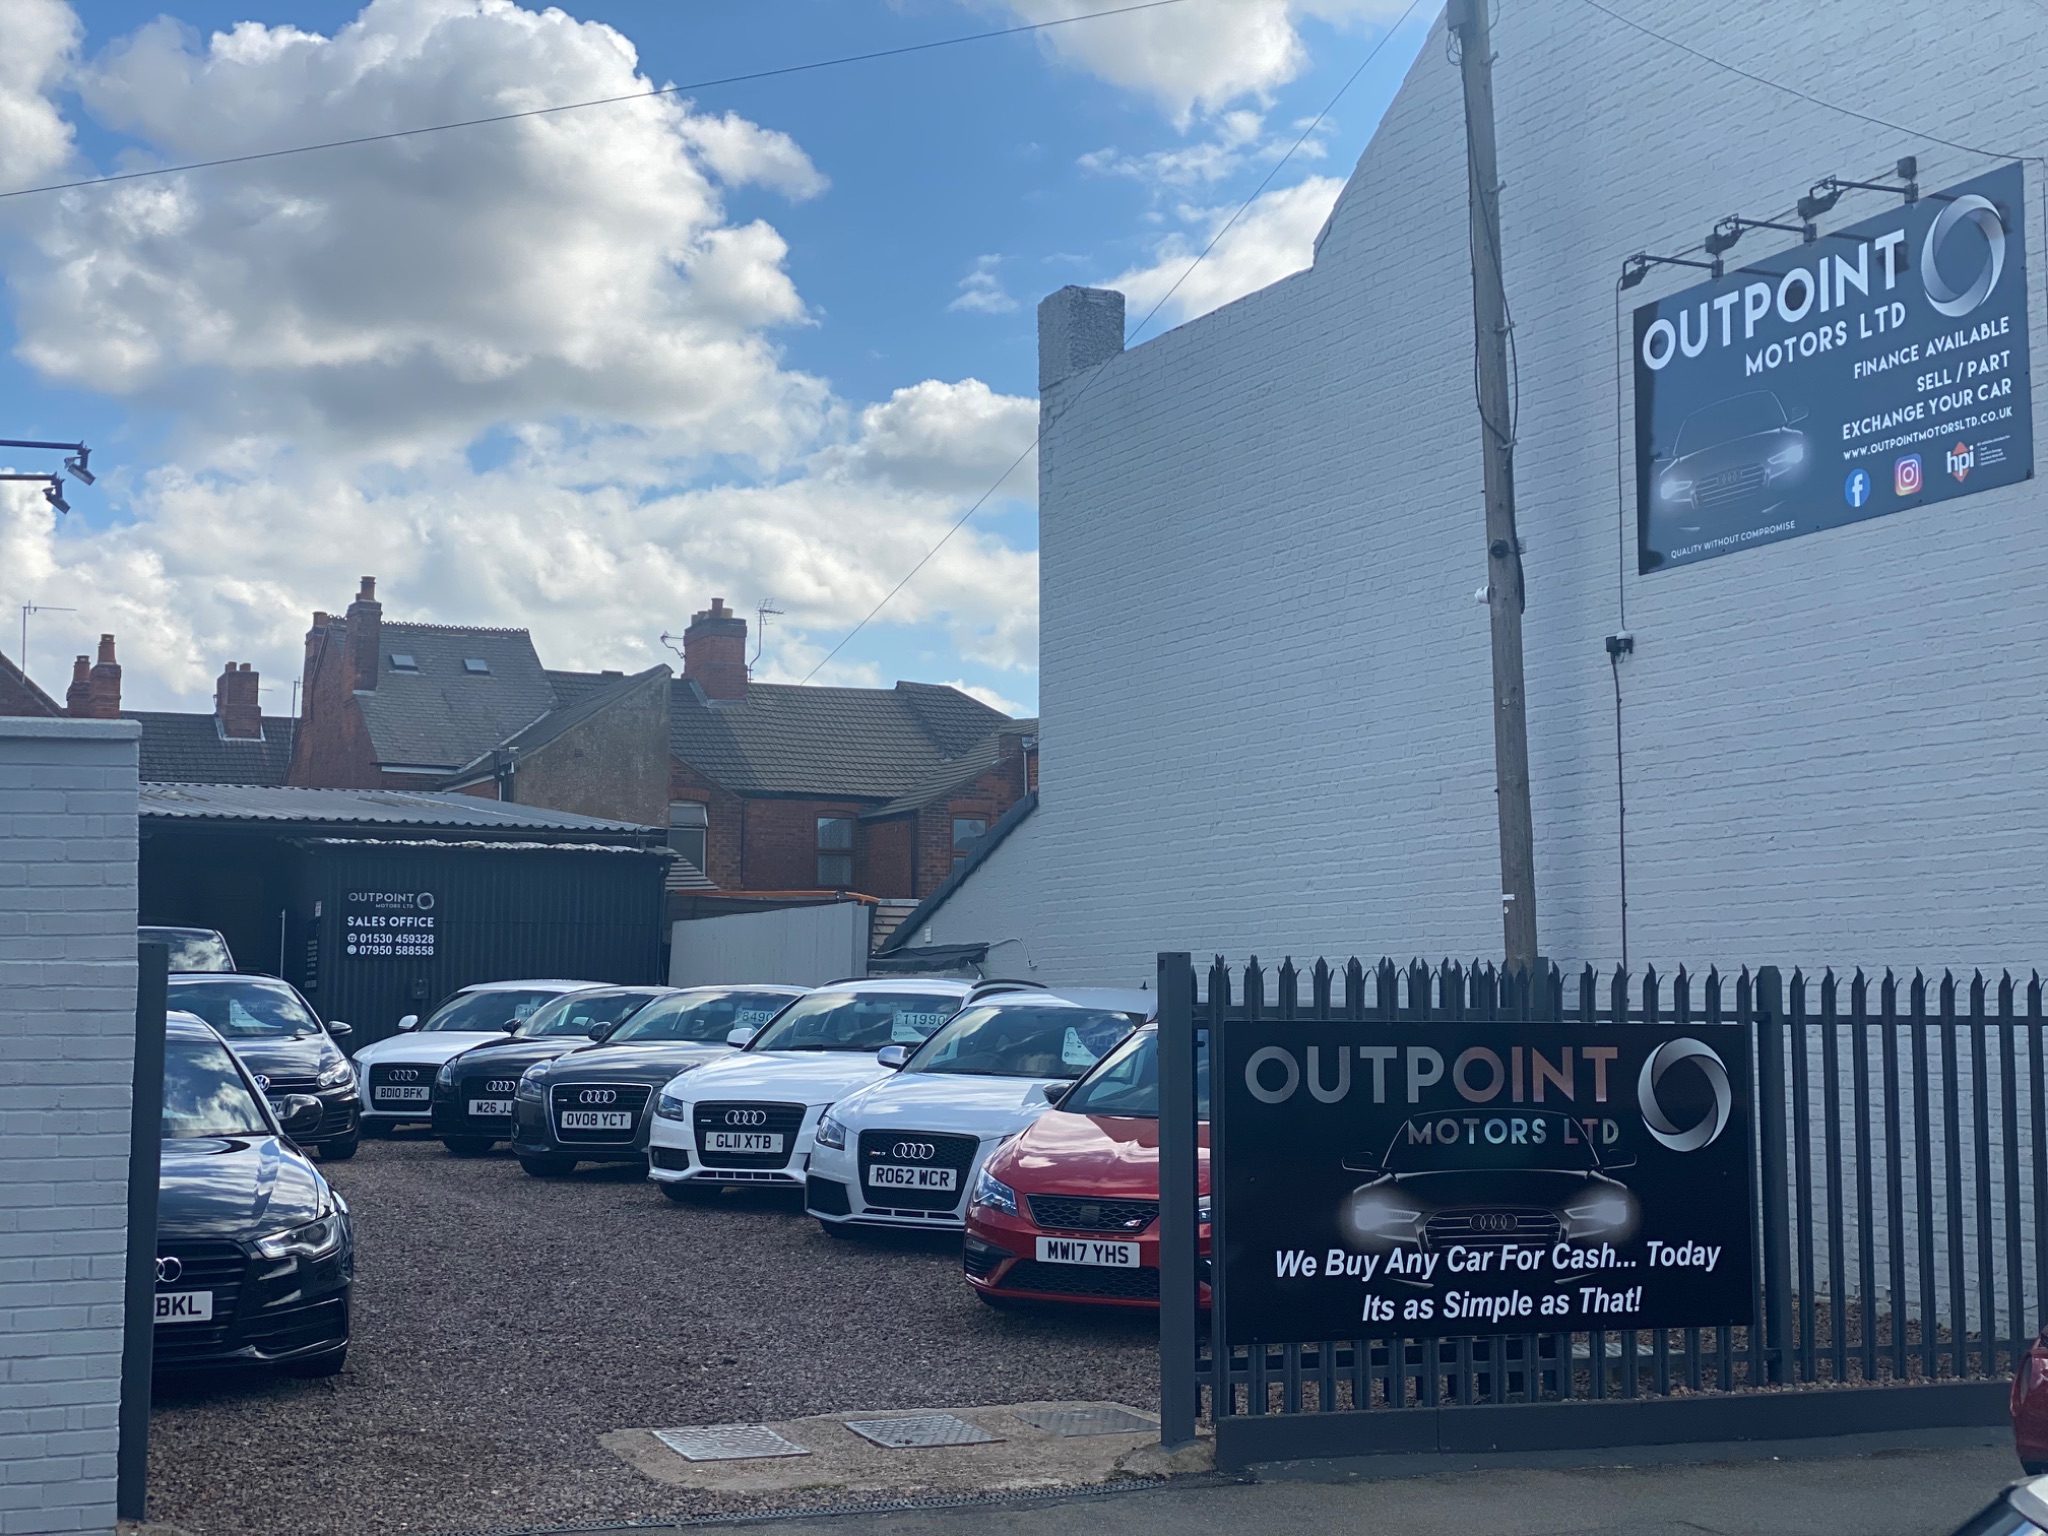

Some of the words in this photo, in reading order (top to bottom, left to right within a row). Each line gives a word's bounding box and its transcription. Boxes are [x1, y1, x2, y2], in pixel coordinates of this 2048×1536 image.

[1642, 229, 1905, 370] OUTPOINT
[1746, 319, 1847, 376] MOTORS
[1860, 302, 1906, 339] LTD
[1854, 344, 1919, 379] FINANCE
[1925, 316, 2010, 357] AVAILABLE
[1917, 369, 1952, 392] SELL
[1967, 350, 2011, 378] PART
[1843, 402, 1925, 440] EXCHANGE
[1928, 389, 1973, 415] YOUR
[1977, 378, 2012, 401] CAR
[1843, 406, 2013, 460] WWW.OUTPOINTMOTORSLTD.CO.UK
[1946, 445, 1975, 477] hpi
[1671, 543, 1703, 559] QUALITY
[1703, 534, 1740, 550] WITHOUT
[1740, 520, 1796, 541] COMPROMISE
[348, 892, 414, 903] OUTPOINT
[347, 916, 386, 927] SALES
[389, 916, 434, 927] OFFICE
[359, 933, 393, 944] 01530
[395, 934, 434, 945] 459328
[359, 945, 392, 955] 07950
[395, 945, 434, 956] 588558
[1244, 1045, 1618, 1104] OUTPOINT
[381, 1086, 401, 1098] BD10
[403, 1086, 423, 1099] BFK
[567, 1113, 598, 1126] OV08
[602, 1114, 626, 1127] YCT
[1407, 1117, 1547, 1146] MOTORS
[1564, 1117, 1620, 1146] LTD
[745, 1134, 771, 1149] XTB
[876, 1167, 914, 1185] RO62
[919, 1170, 950, 1187] WCR
[1047, 1241, 1087, 1262] MW17
[1093, 1244, 1129, 1264] YHS
[1275, 1249, 1317, 1277] We
[1325, 1247, 1378, 1281] Buy
[1385, 1247, 1439, 1280] Any
[1446, 1245, 1493, 1273] Car
[1500, 1243, 1546, 1271] For
[1551, 1241, 1638, 1270] Cash...
[1646, 1240, 1721, 1273] Today
[155, 1295, 202, 1317] BKL
[1363, 1294, 1395, 1321] Its
[1403, 1299, 1434, 1320] as
[1443, 1290, 1532, 1323] Simple
[1540, 1294, 1571, 1315] as
[1579, 1286, 1642, 1314] That!
